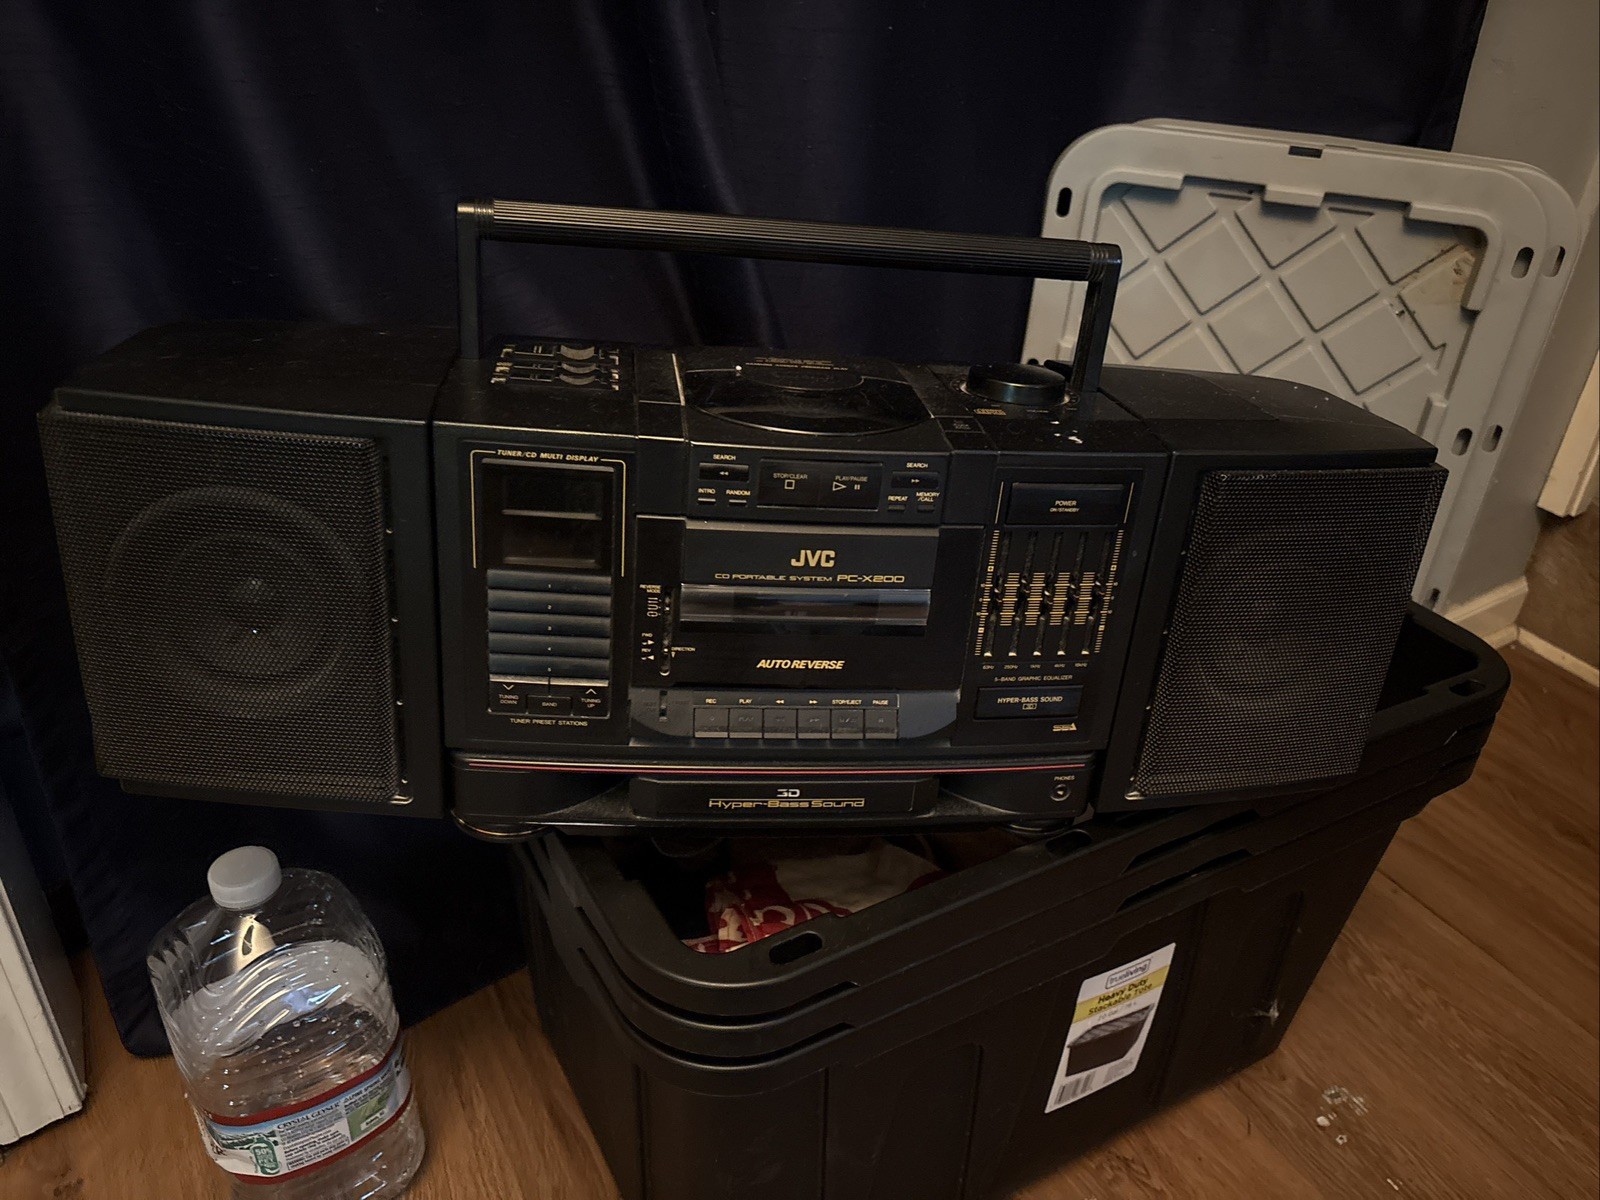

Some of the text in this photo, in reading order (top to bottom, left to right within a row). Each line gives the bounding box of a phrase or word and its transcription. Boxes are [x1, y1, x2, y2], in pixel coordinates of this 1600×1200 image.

[497, 449, 599, 462] TUNER/CD MULTI DISPLAY
[790, 549, 836, 568] JVC
[732, 573, 786, 581] PORTABLE
[837, 575, 905, 583] PC-X200
[757, 659, 845, 669] AUTO REVERSE
[997, 696, 1039, 704] HYPER-BASS
[776, 788, 800, 798] 3D
[708, 799, 865, 809] Hyper-Bass Sound
[1097, 978, 1149, 1004] Heavy Duty
[1088, 993, 1132, 1015] Stackable
[277, 1113, 311, 1130] CRYSTAL
[311, 1102, 340, 1119] GEYSER
